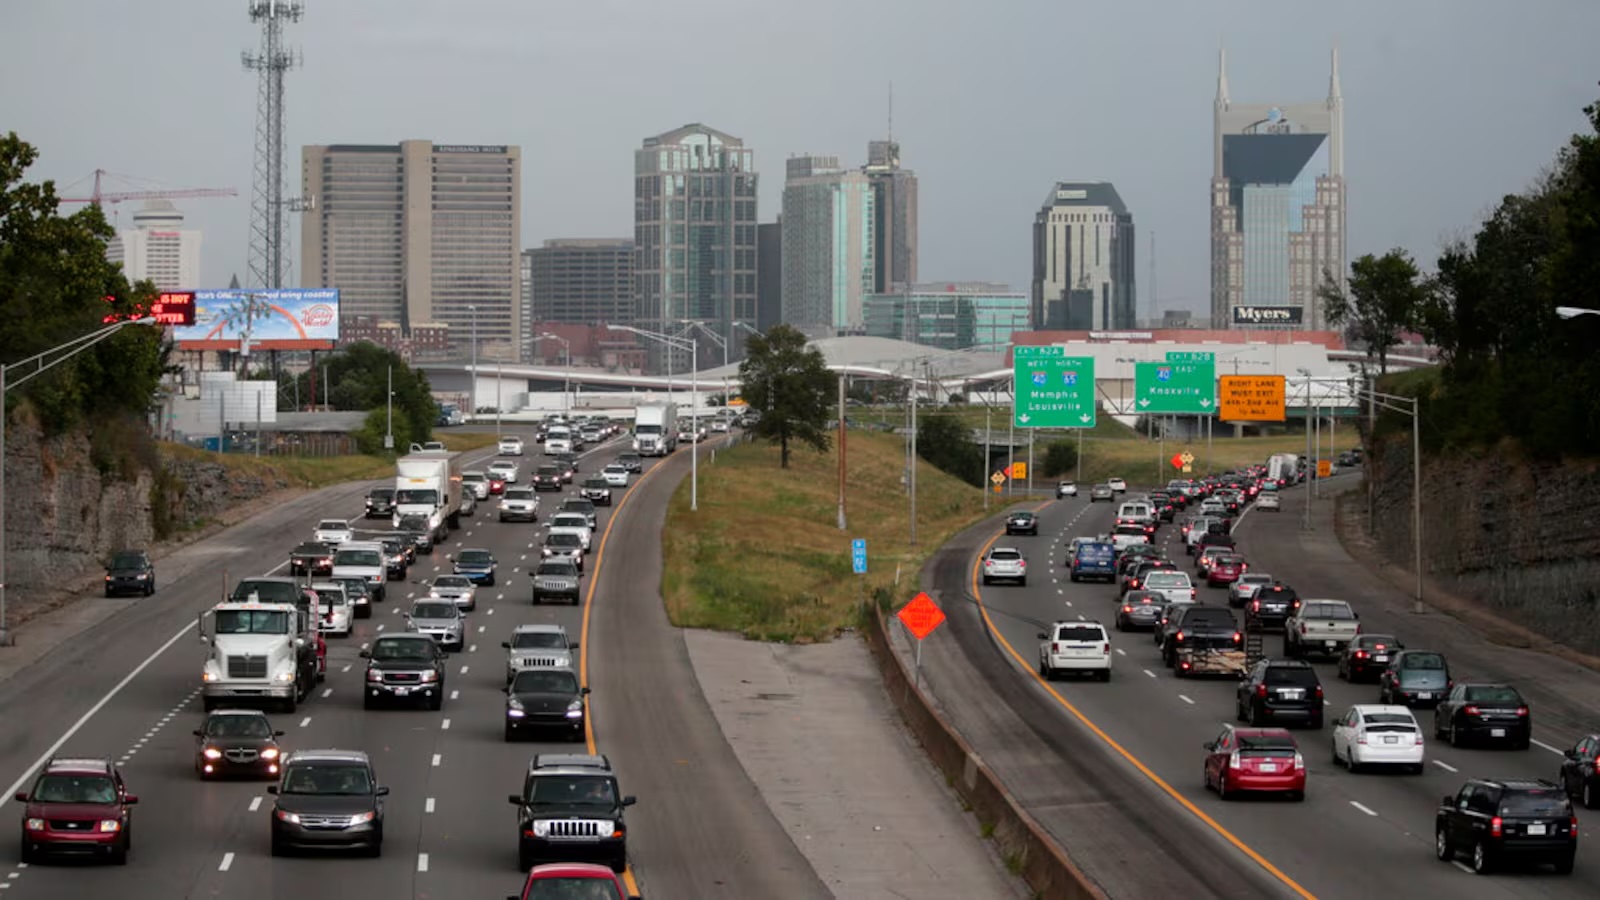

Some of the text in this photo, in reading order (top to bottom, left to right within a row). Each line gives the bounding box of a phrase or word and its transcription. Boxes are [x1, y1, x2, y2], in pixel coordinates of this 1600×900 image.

[1238, 307, 1290, 322] Myers
[1157, 371, 1170, 379] 40
[1030, 391, 1078, 400] Memphis
[1149, 387, 1200, 395] Knoxville
[1028, 402, 1081, 411] Louisville
